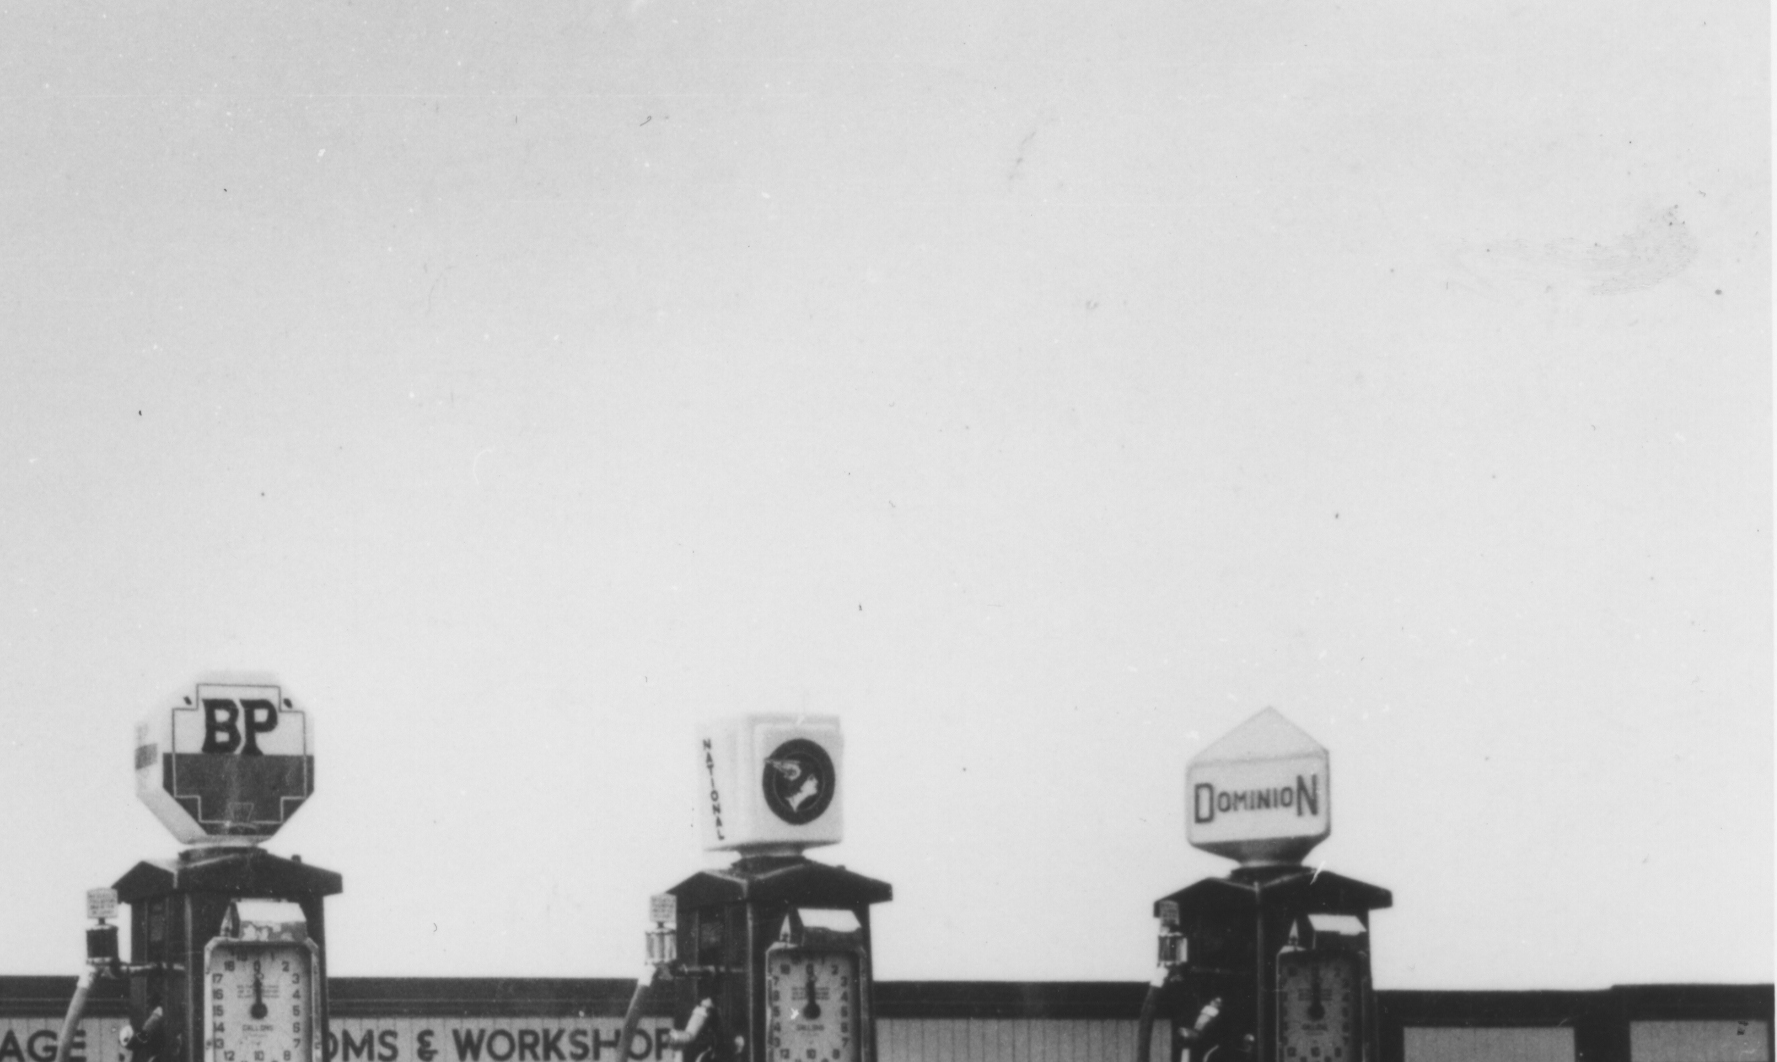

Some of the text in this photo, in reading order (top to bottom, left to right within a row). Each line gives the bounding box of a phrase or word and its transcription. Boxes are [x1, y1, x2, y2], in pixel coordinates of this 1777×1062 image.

[703, 739, 725, 840] NATIONAL
[282, 961, 289, 972] 2
[213, 973, 223, 984] 17
[292, 973, 300, 984] 3
[292, 989, 300, 999] 4
[293, 1038, 301, 1048] 7
[417, 1029, 438, 1062] &
[224, 1050, 235, 1061] 12
[254, 1050, 264, 1061] 10
